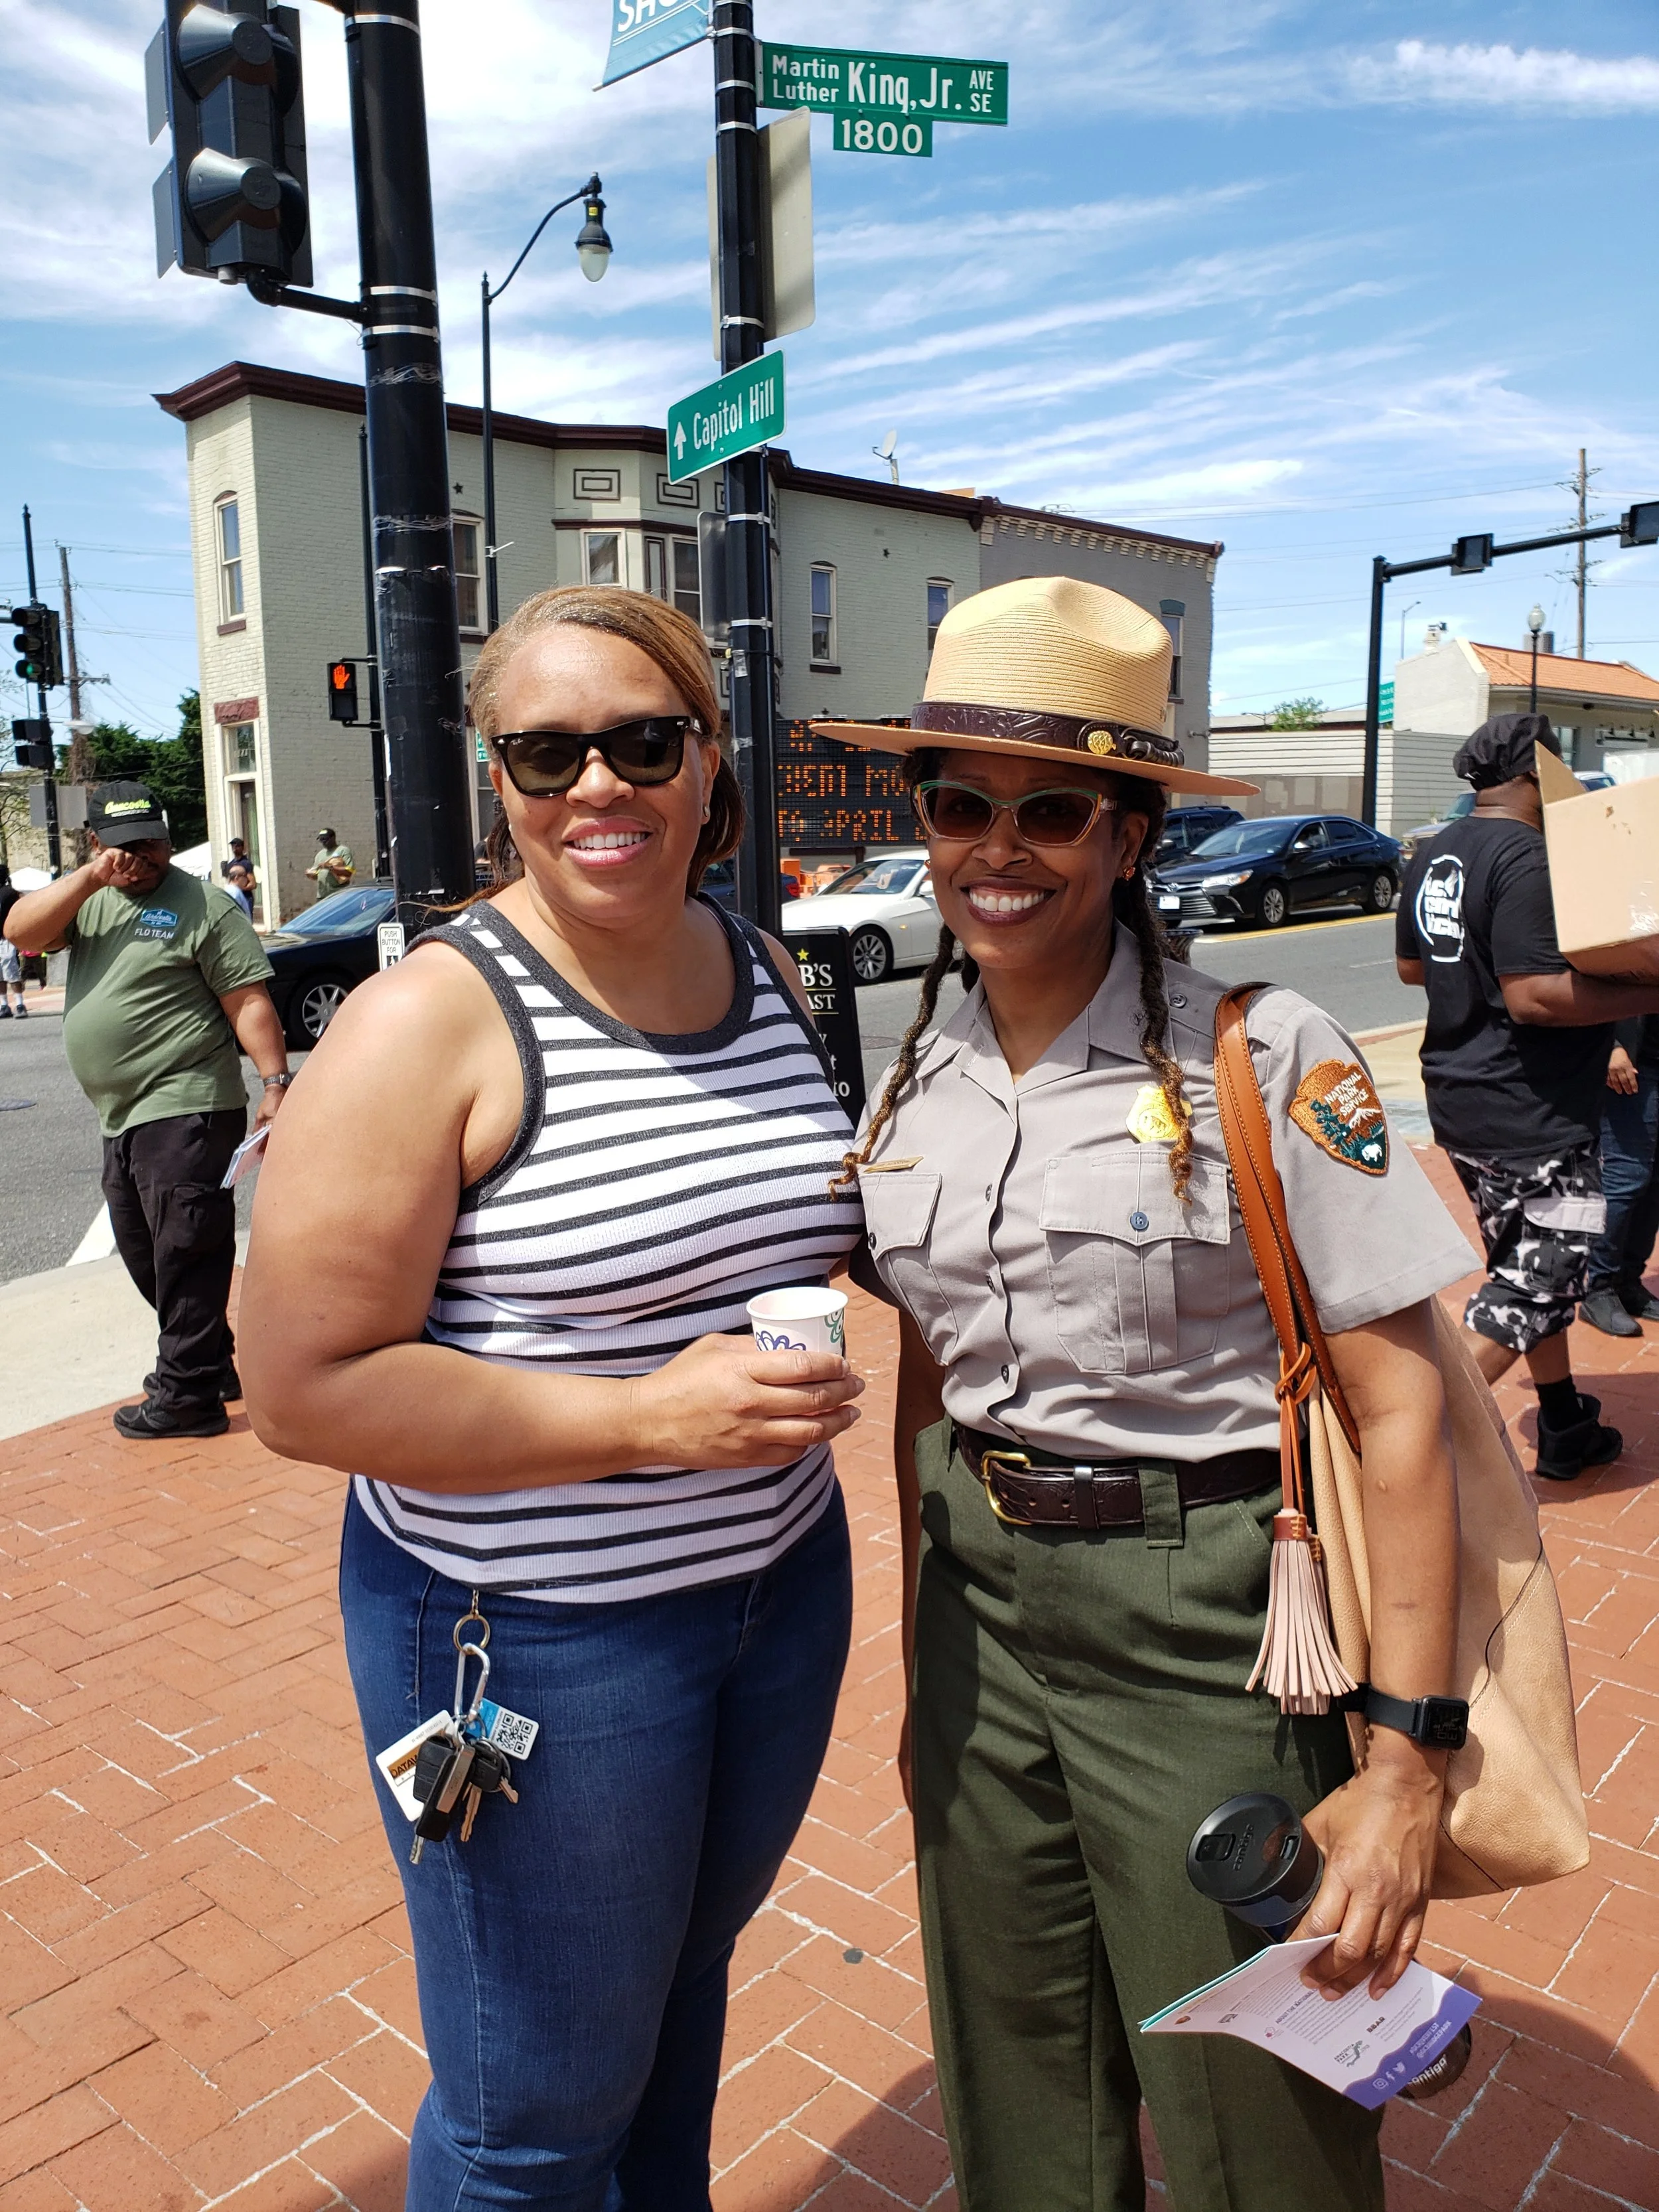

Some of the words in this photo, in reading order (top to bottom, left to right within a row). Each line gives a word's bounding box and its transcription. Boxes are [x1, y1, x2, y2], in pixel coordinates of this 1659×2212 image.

[772, 54, 839, 80] Martin
[969, 70, 994, 90] AVE
[773, 78, 839, 103] Luther
[970, 93, 992, 113] SE
[841, 119, 923, 154] 1800
[693, 392, 743, 452] Capitol
[749, 376, 774, 424] Hill
[151, 930, 175, 939] TEAM
[1324, 1072, 1362, 1105] NATIONAL
[1337, 1086, 1360, 1105] PARK
[1339, 1089, 1369, 1117] SERVICE
[1407, 2057, 1447, 2085] ontigo
